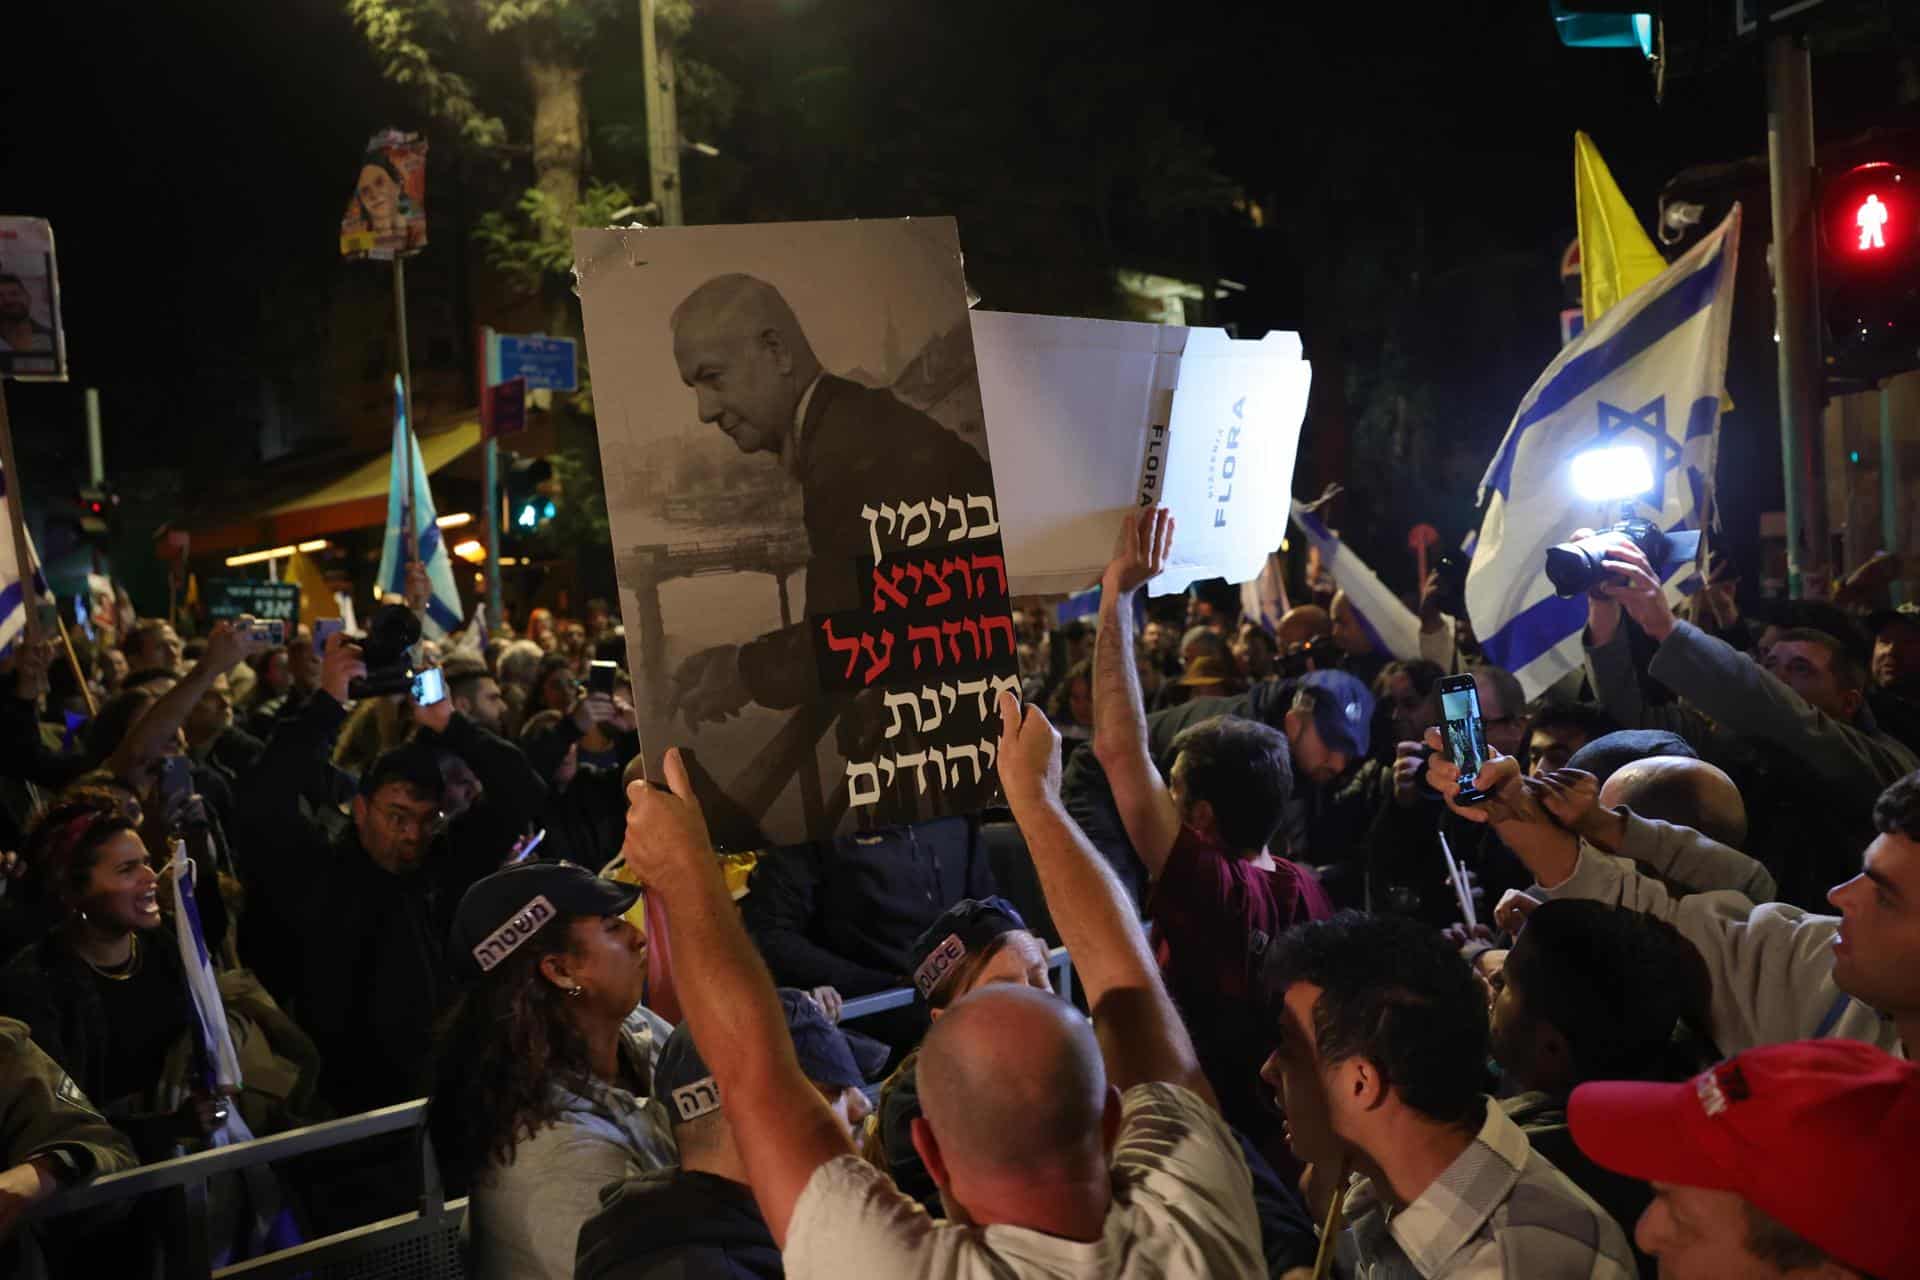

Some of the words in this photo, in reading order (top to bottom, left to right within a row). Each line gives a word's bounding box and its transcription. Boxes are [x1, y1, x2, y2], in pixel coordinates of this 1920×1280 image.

[1140, 424, 1164, 507] FLORA
[1214, 395, 1246, 528] FLORA
[861, 493, 1000, 567] בנימין
[872, 552, 1007, 614] הוציא
[821, 616, 895, 685] על
[908, 614, 1014, 670] חוזה
[845, 734, 1001, 807] יהודים
[478, 903, 549, 966] משטרה
[920, 942, 959, 996] OLICE
